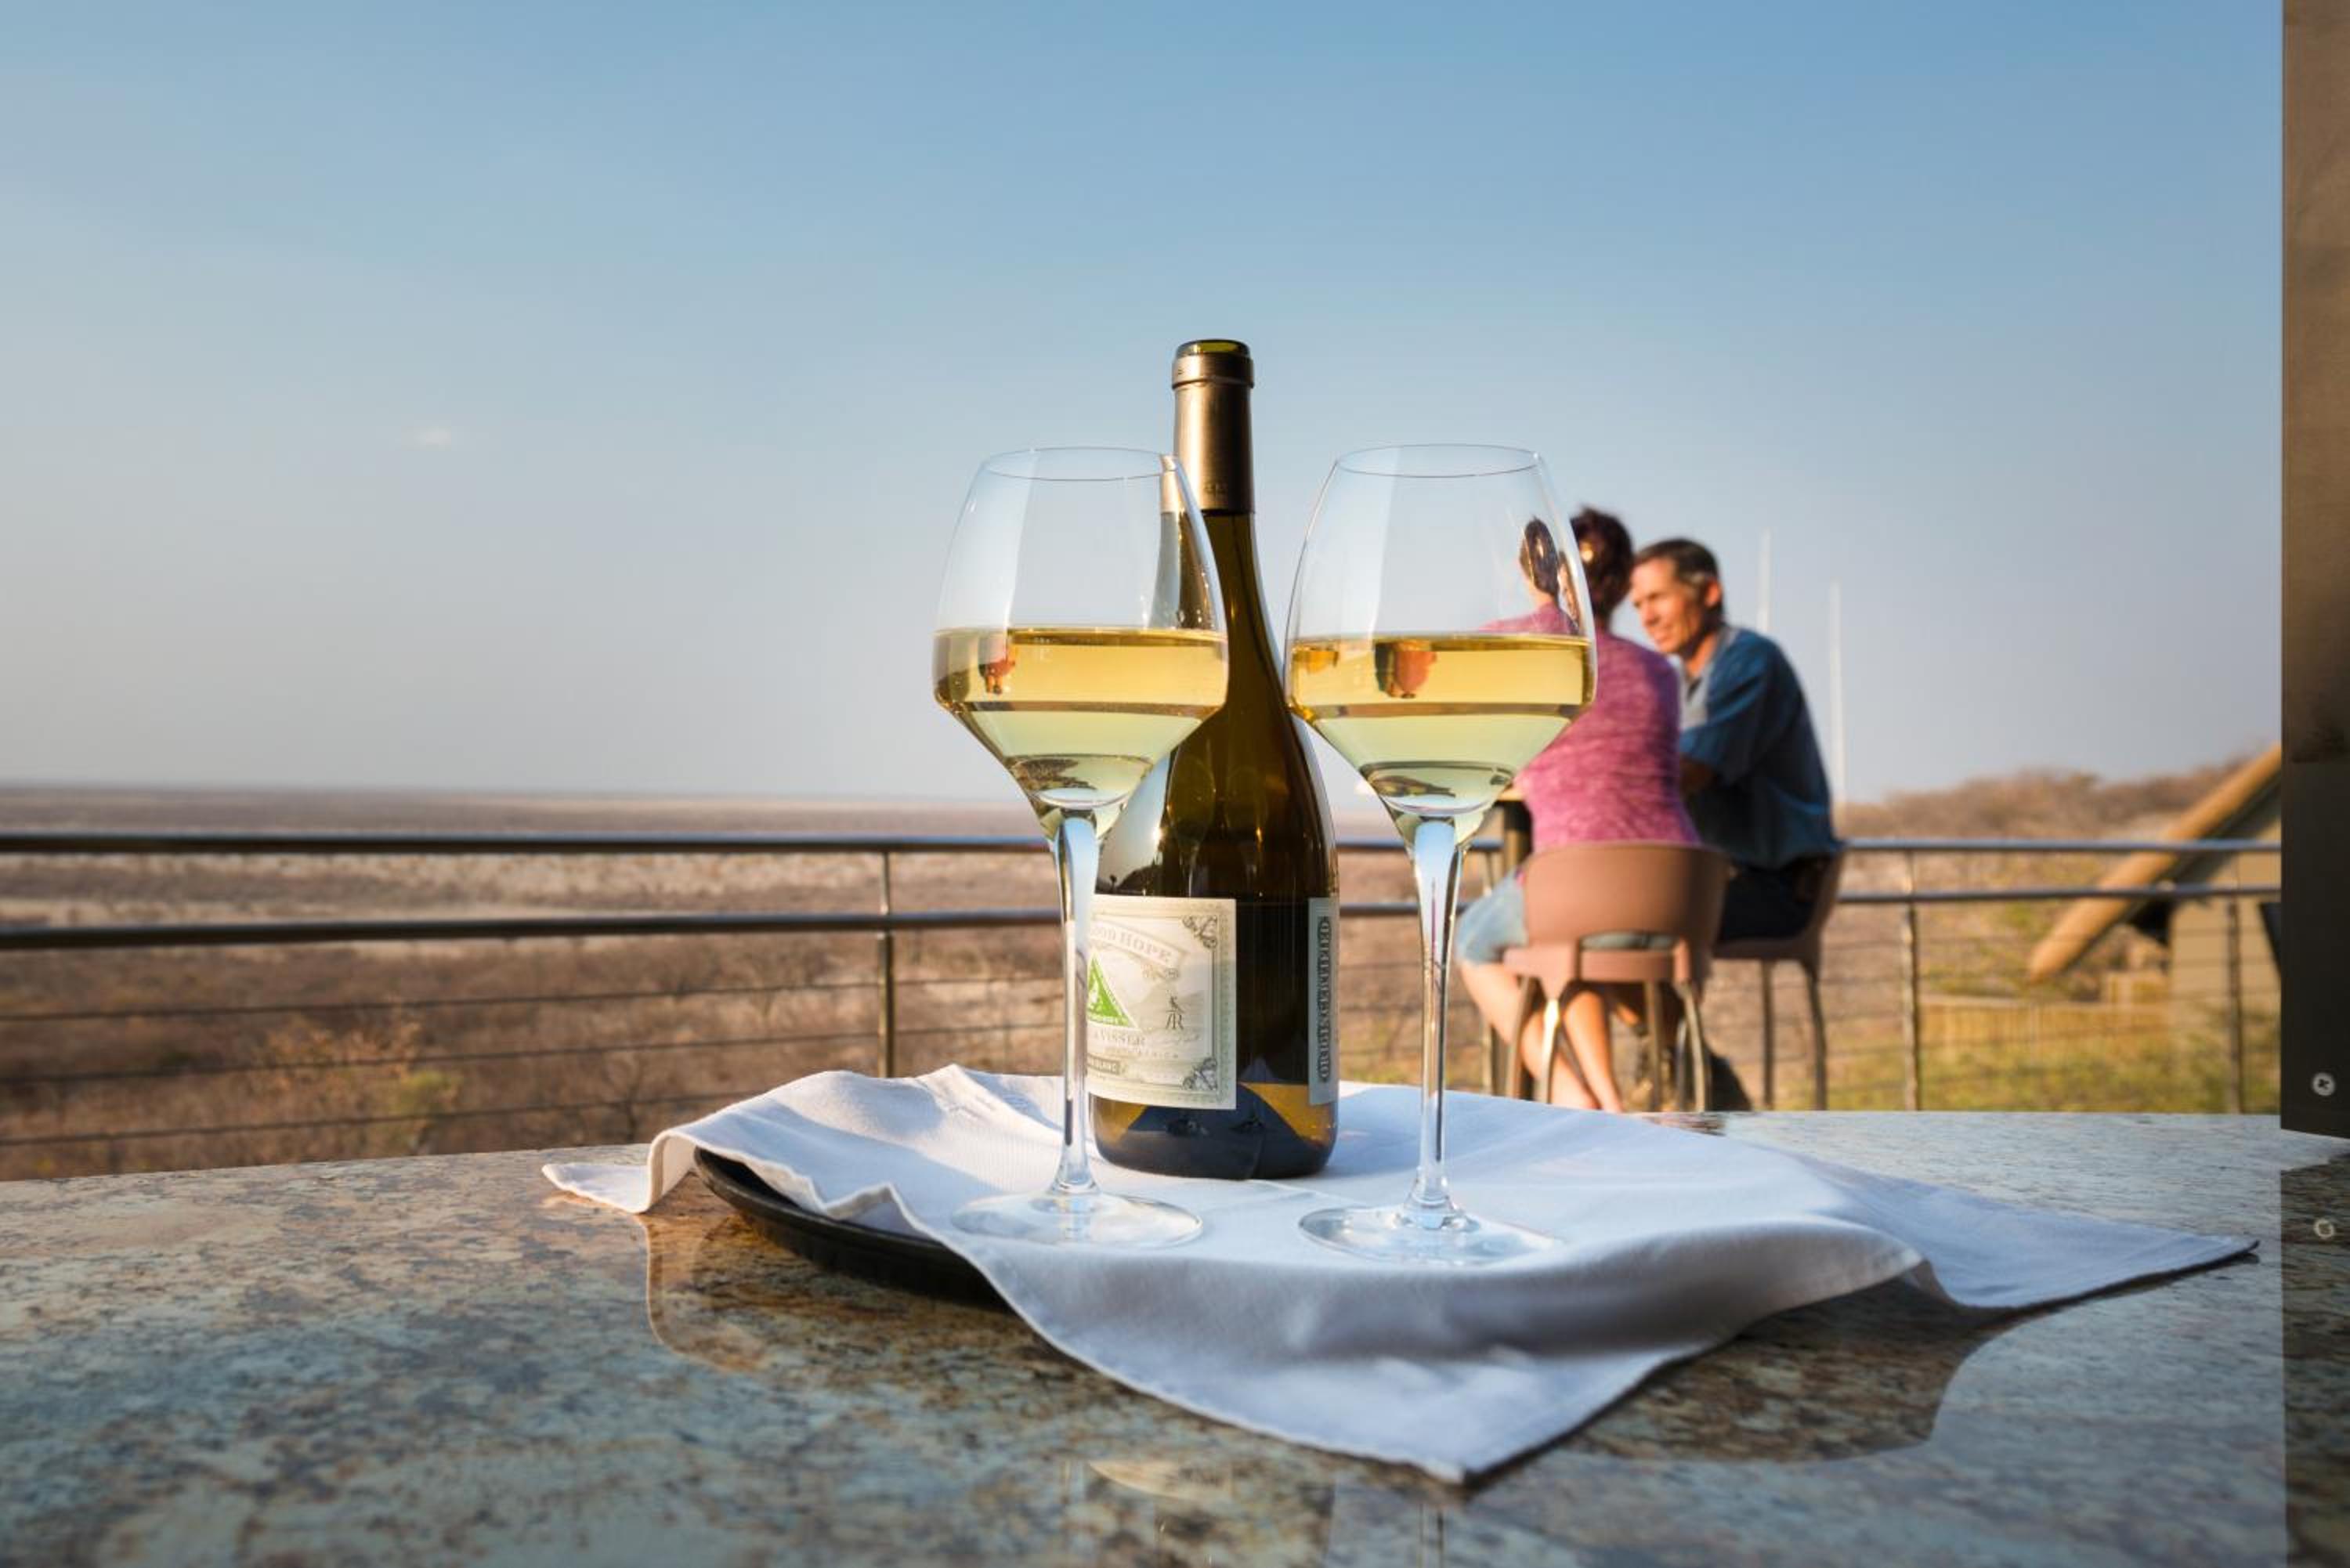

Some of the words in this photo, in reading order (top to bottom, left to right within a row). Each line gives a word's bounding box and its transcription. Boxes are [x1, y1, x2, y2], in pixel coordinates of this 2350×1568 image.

[1120, 930, 1173, 963] HOPE
[1320, 923, 1330, 1014] CERTIFIED
[1320, 1017, 1330, 1078] ORIGIN
